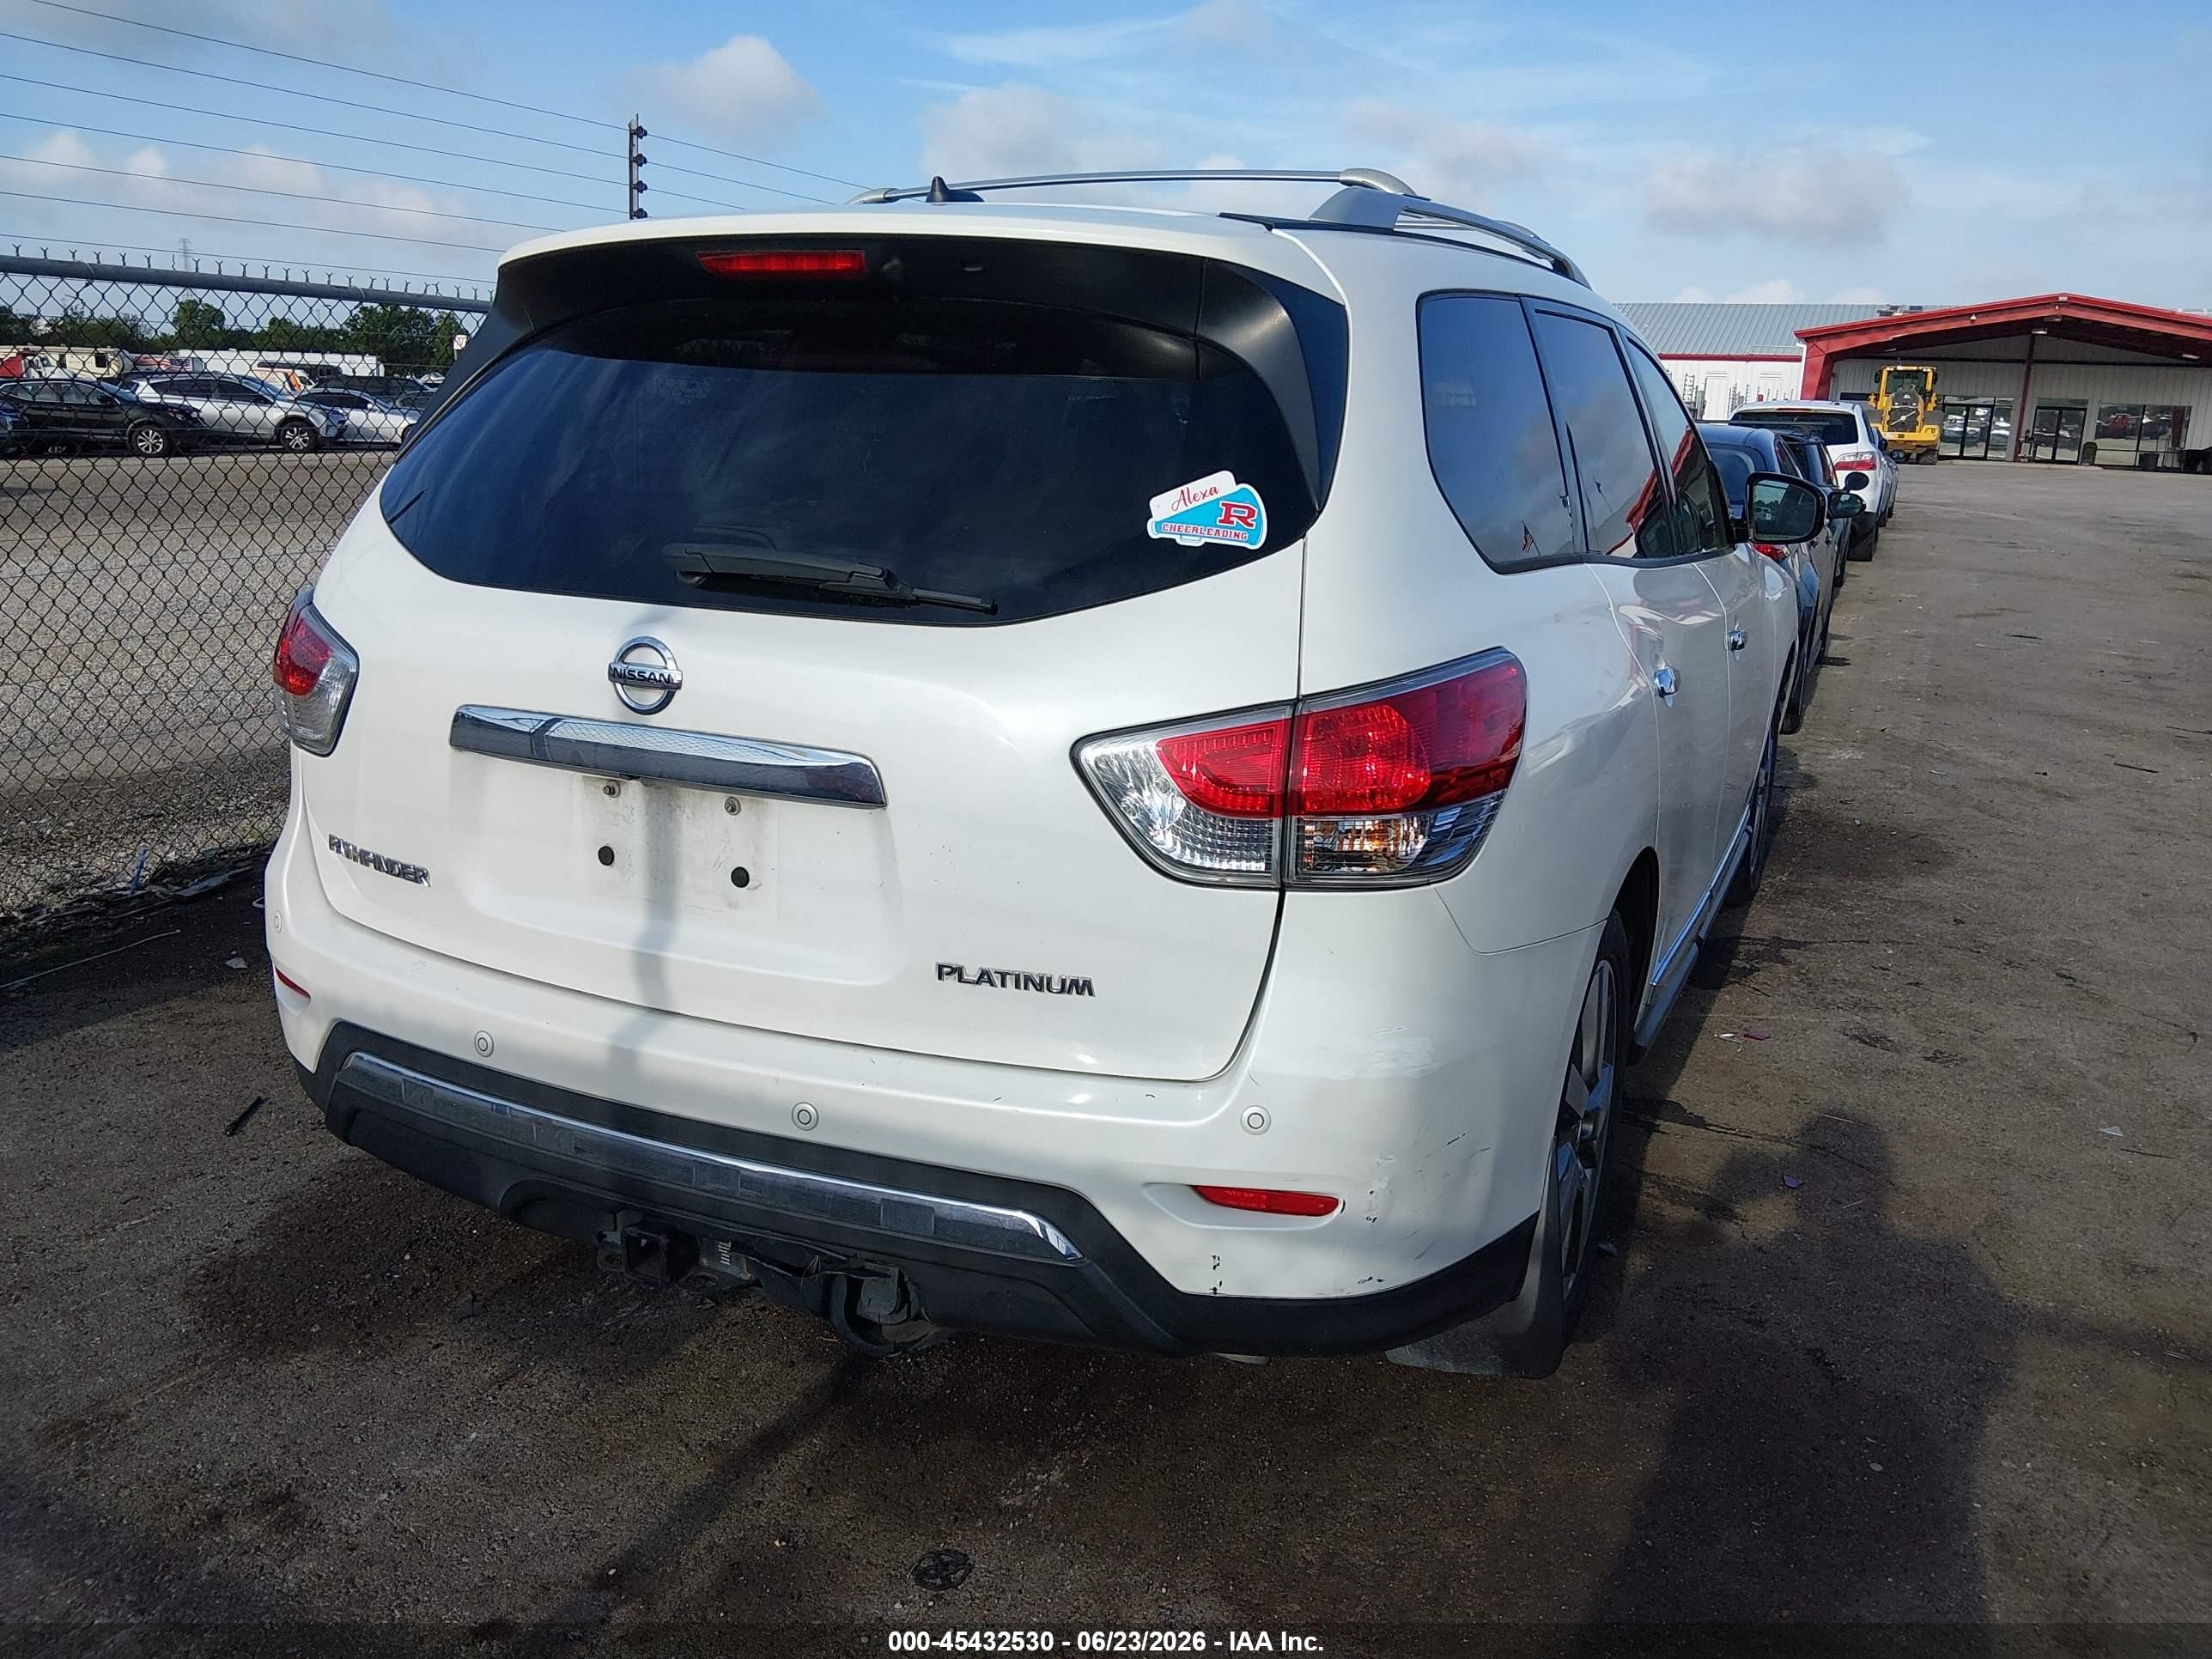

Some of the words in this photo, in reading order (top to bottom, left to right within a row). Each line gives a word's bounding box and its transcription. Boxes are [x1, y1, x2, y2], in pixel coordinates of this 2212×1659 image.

[1171, 485, 1219, 512] Alexa
[1218, 502, 1256, 527] R
[1162, 523, 1248, 541] CHEERLEADING
[612, 667, 672, 684] NISSAN
[935, 962, 1096, 997] PLATINUM
